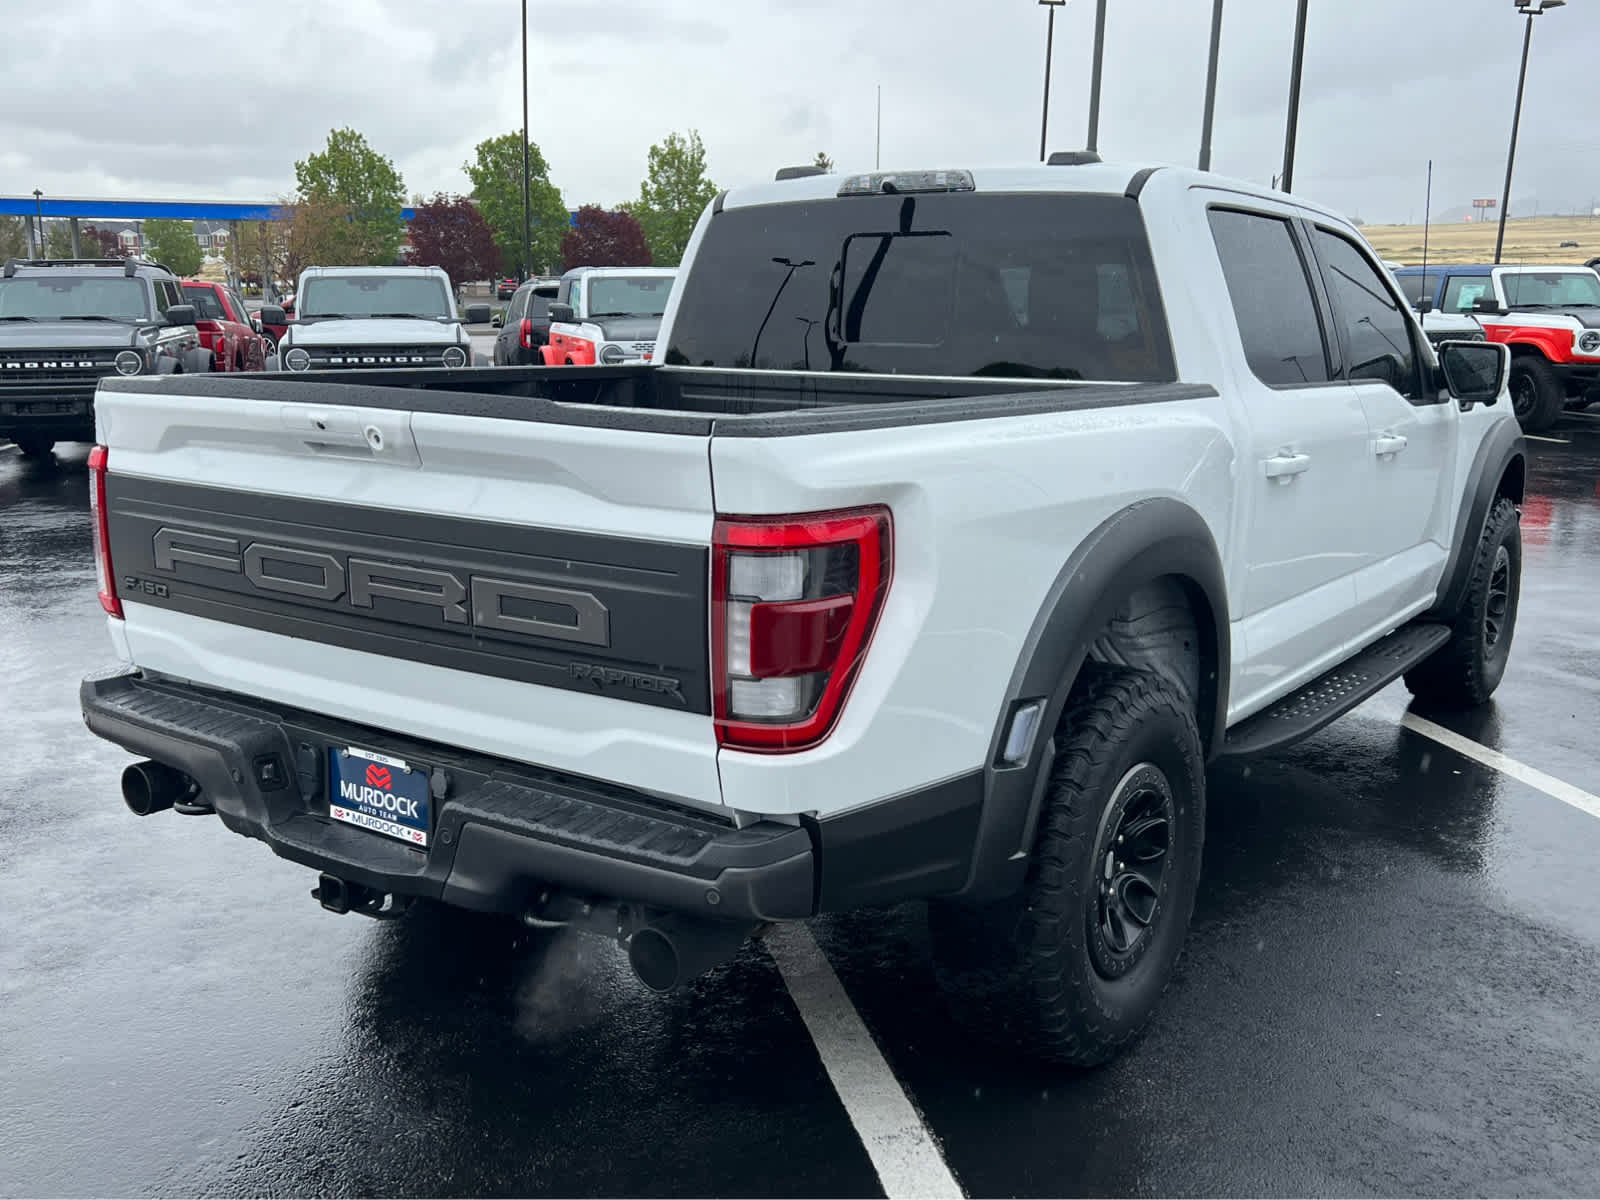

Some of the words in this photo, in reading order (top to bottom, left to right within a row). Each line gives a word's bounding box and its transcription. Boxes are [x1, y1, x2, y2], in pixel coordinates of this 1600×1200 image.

[0, 361, 93, 369] RONCO
[153, 527, 610, 647] FORD
[570, 661, 686, 704] RAPTOR
[340, 780, 418, 819] MURDOCK
[359, 804, 377, 816] AUTO
[379, 810, 398, 821] TEAM
[351, 812, 404, 837] MURDOCK
